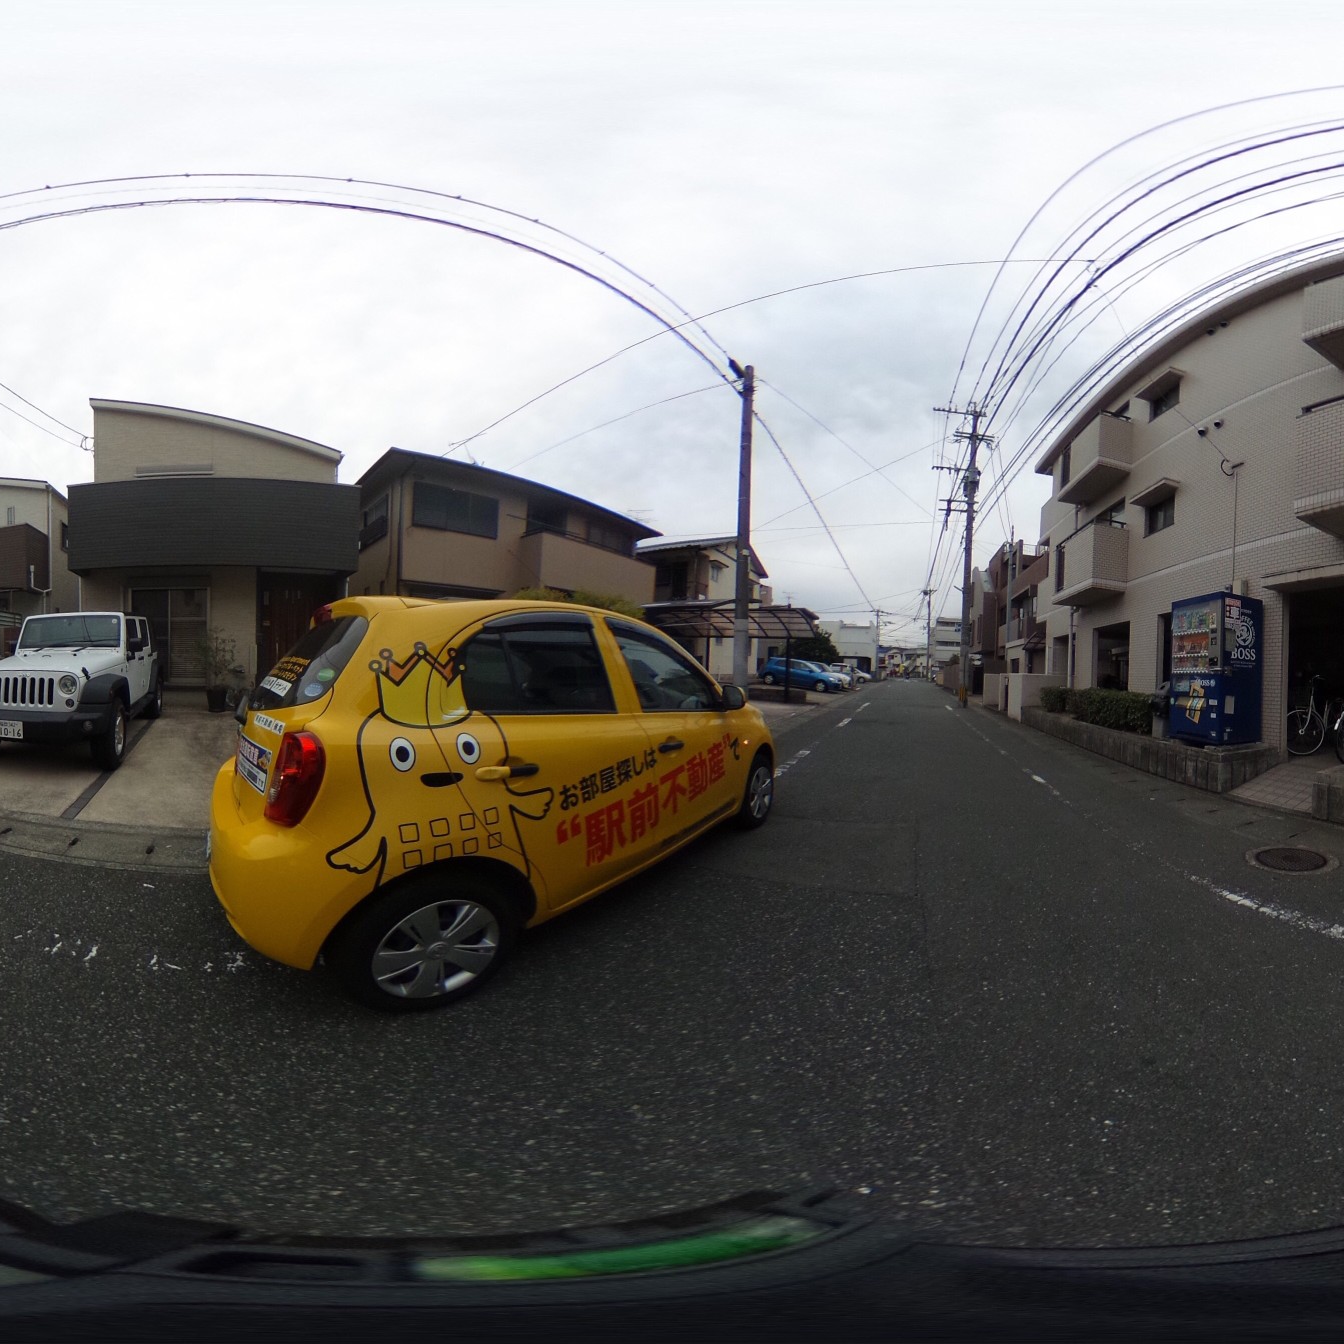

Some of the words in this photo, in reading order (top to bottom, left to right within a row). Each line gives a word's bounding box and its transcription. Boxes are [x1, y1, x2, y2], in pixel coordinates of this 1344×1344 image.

[1231, 647, 1256, 660] BOSS
[559, 748, 658, 811] お部屋探しは
